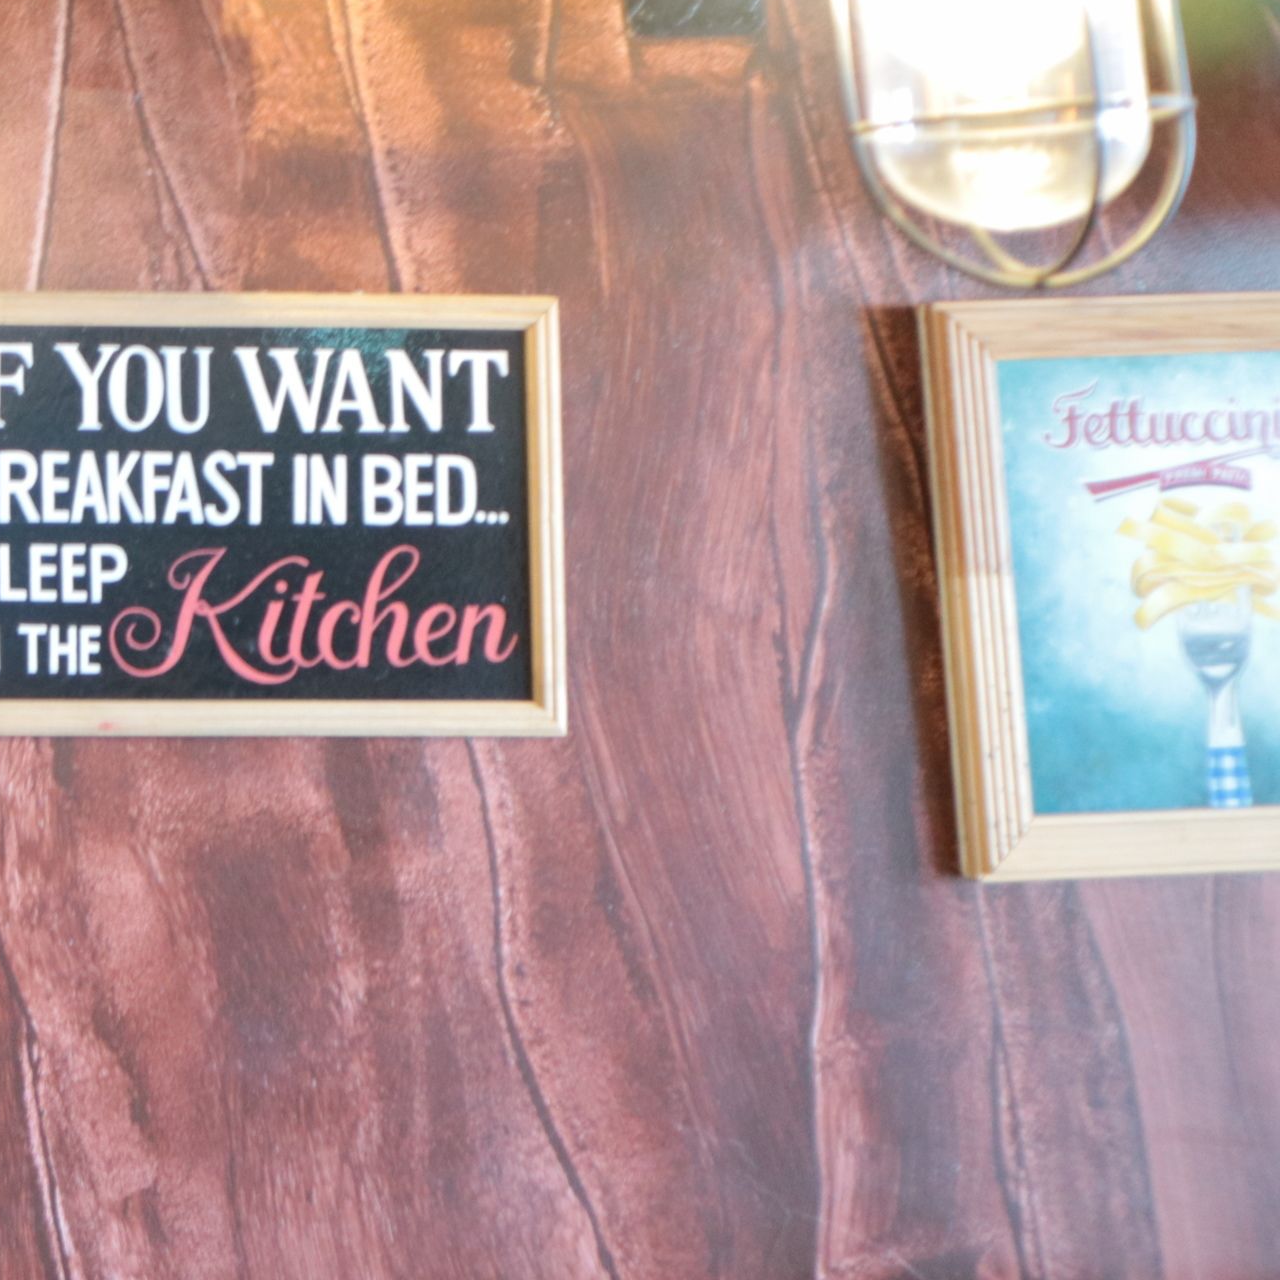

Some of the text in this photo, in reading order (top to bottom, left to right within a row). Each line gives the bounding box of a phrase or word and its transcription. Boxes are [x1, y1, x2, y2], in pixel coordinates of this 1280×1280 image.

[53, 343, 213, 432] YOU
[234, 345, 509, 433] WANT
[292, 453, 347, 524] IN
[362, 454, 509, 526] BED...
[18, 623, 102, 675] THE
[109, 544, 519, 685] Kitchen
